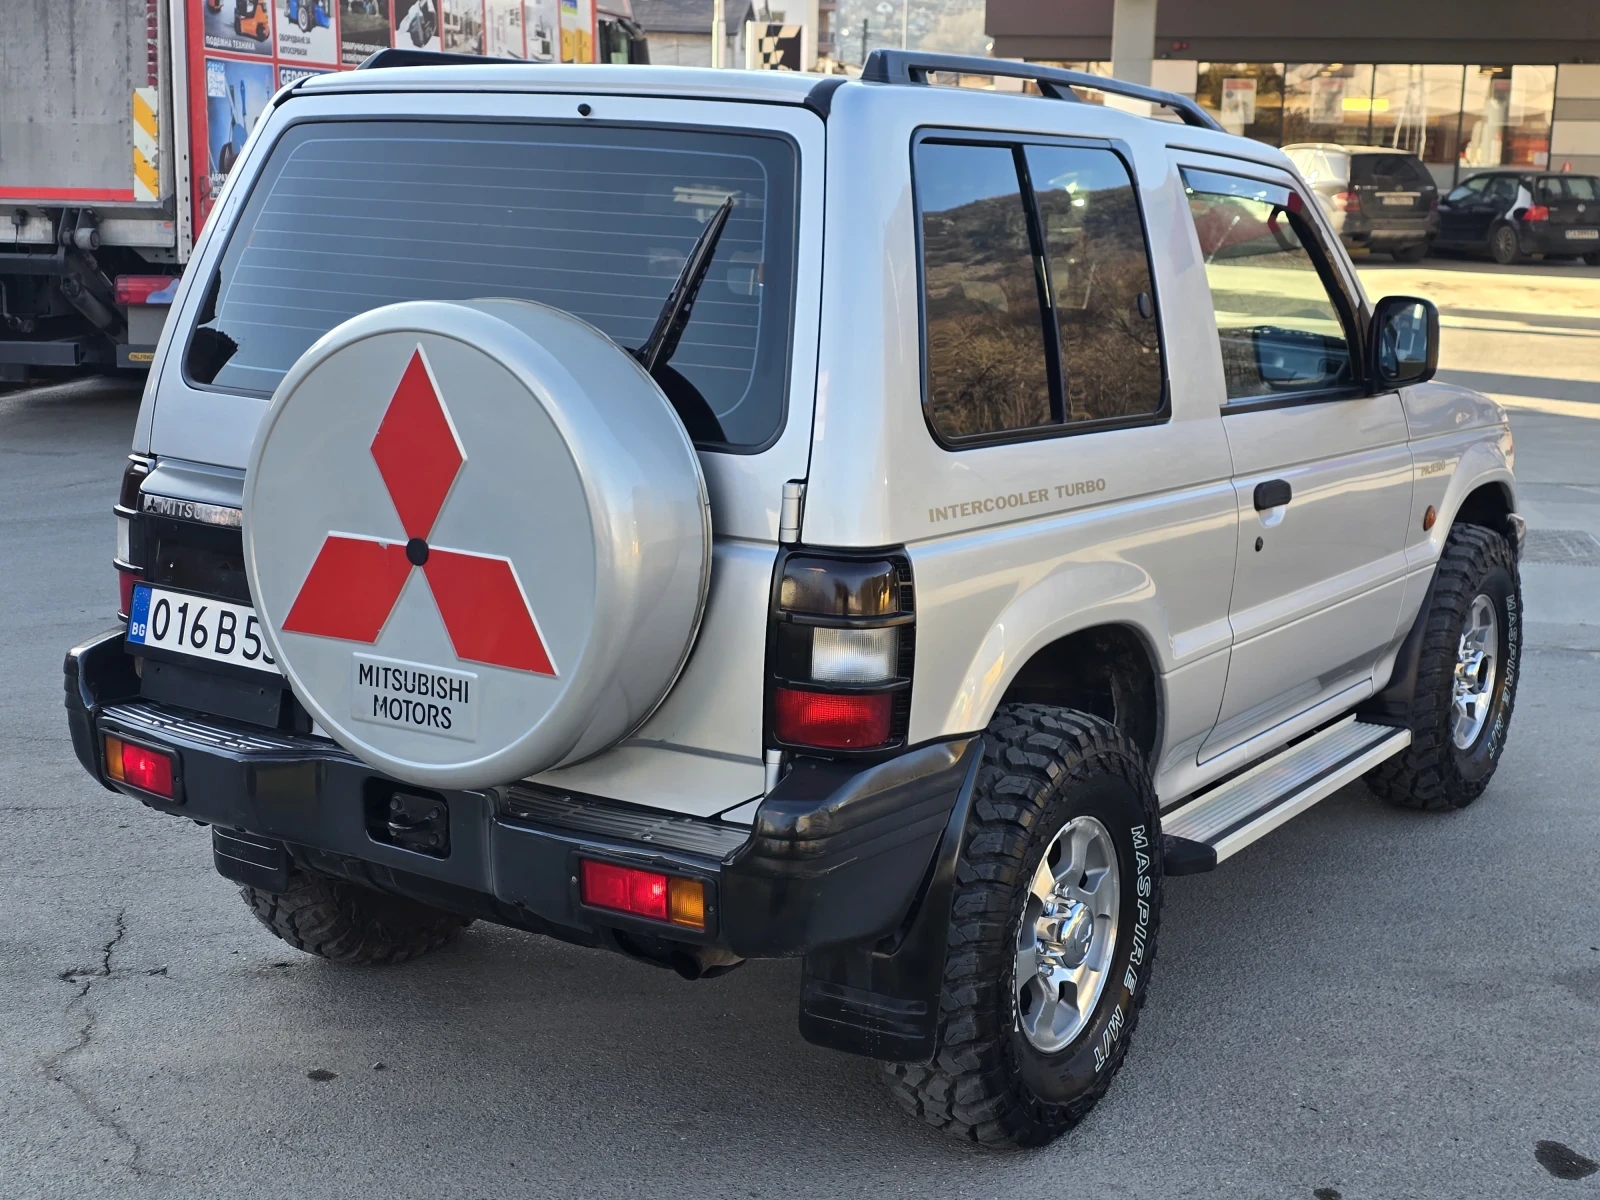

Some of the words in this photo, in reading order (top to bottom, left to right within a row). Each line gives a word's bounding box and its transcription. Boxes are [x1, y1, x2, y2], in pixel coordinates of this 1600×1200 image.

[206, 35, 232, 48] ПОДЕМНА
[233, 40, 256, 50] ТЕХНИКА
[928, 488, 1049, 523] INTERCOOLER
[1054, 478, 1106, 499] TURBO
[131, 622, 147, 637] BG
[359, 663, 469, 704] MITSUBISHI
[373, 694, 452, 730] MOTORS
[1123, 824, 1151, 996] MASPIRE
[1094, 1004, 1125, 1074] M/T
